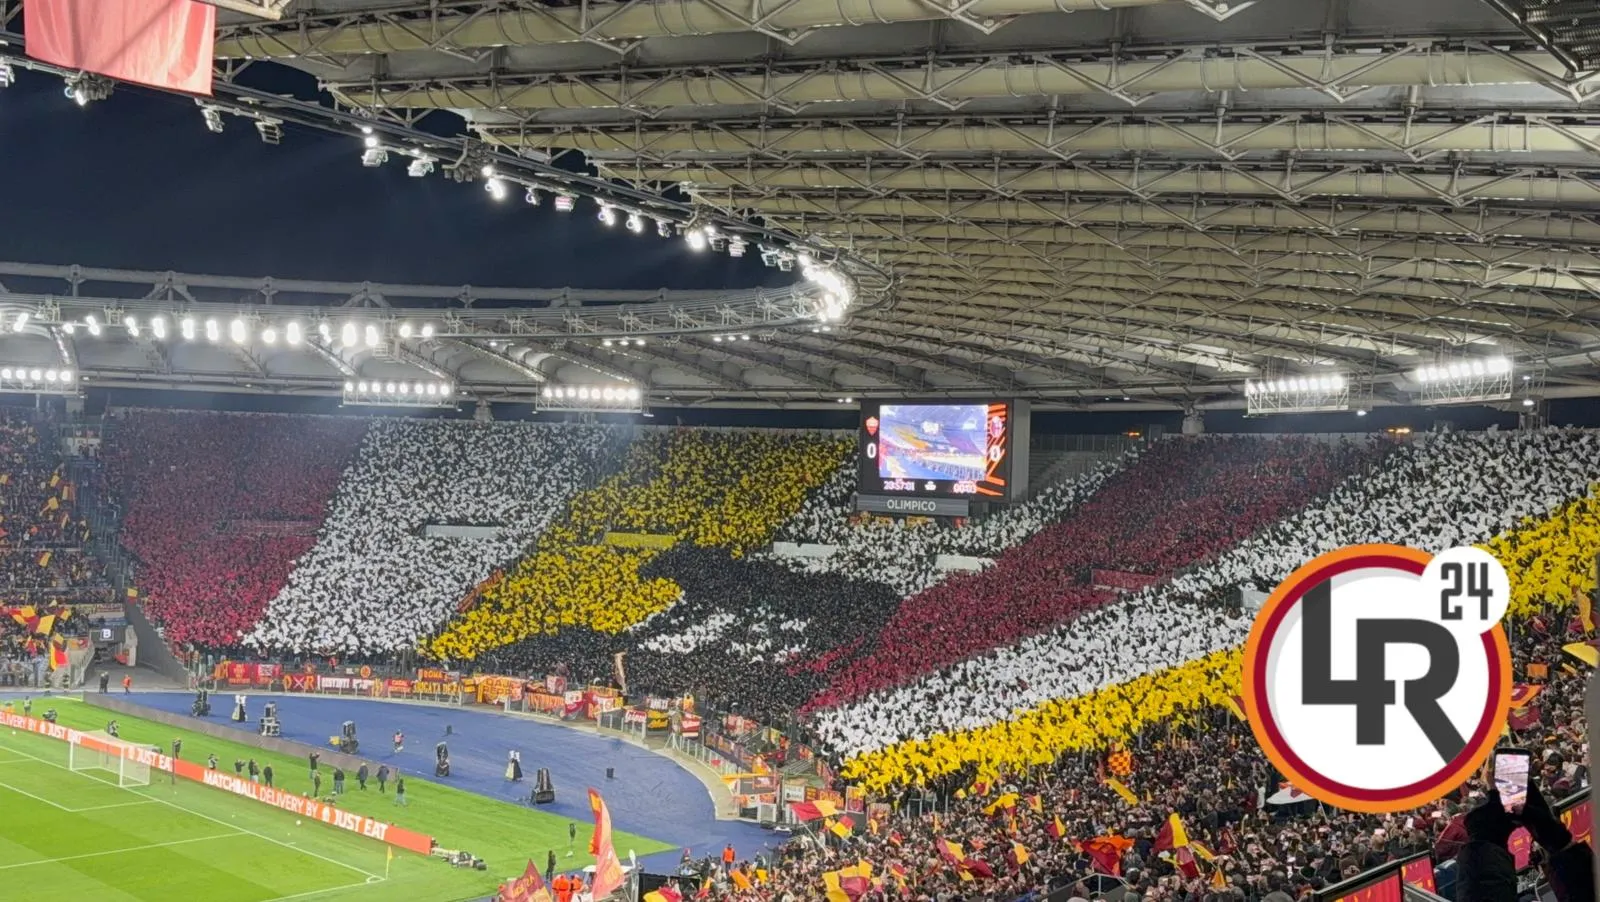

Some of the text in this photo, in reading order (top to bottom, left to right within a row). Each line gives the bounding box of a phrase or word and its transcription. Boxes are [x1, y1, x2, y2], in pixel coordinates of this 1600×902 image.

[866, 442, 877, 459] 0
[990, 444, 1001, 462] 0
[886, 499, 936, 511] OLIMPICO
[103, 629, 111, 638] B
[48, 722, 65, 740] JUST
[136, 747, 154, 766] JUST
[259, 786, 304, 814] DELIVERY
[306, 800, 318, 817] BY
[334, 809, 361, 832] JUST
[363, 818, 387, 840] EAT
